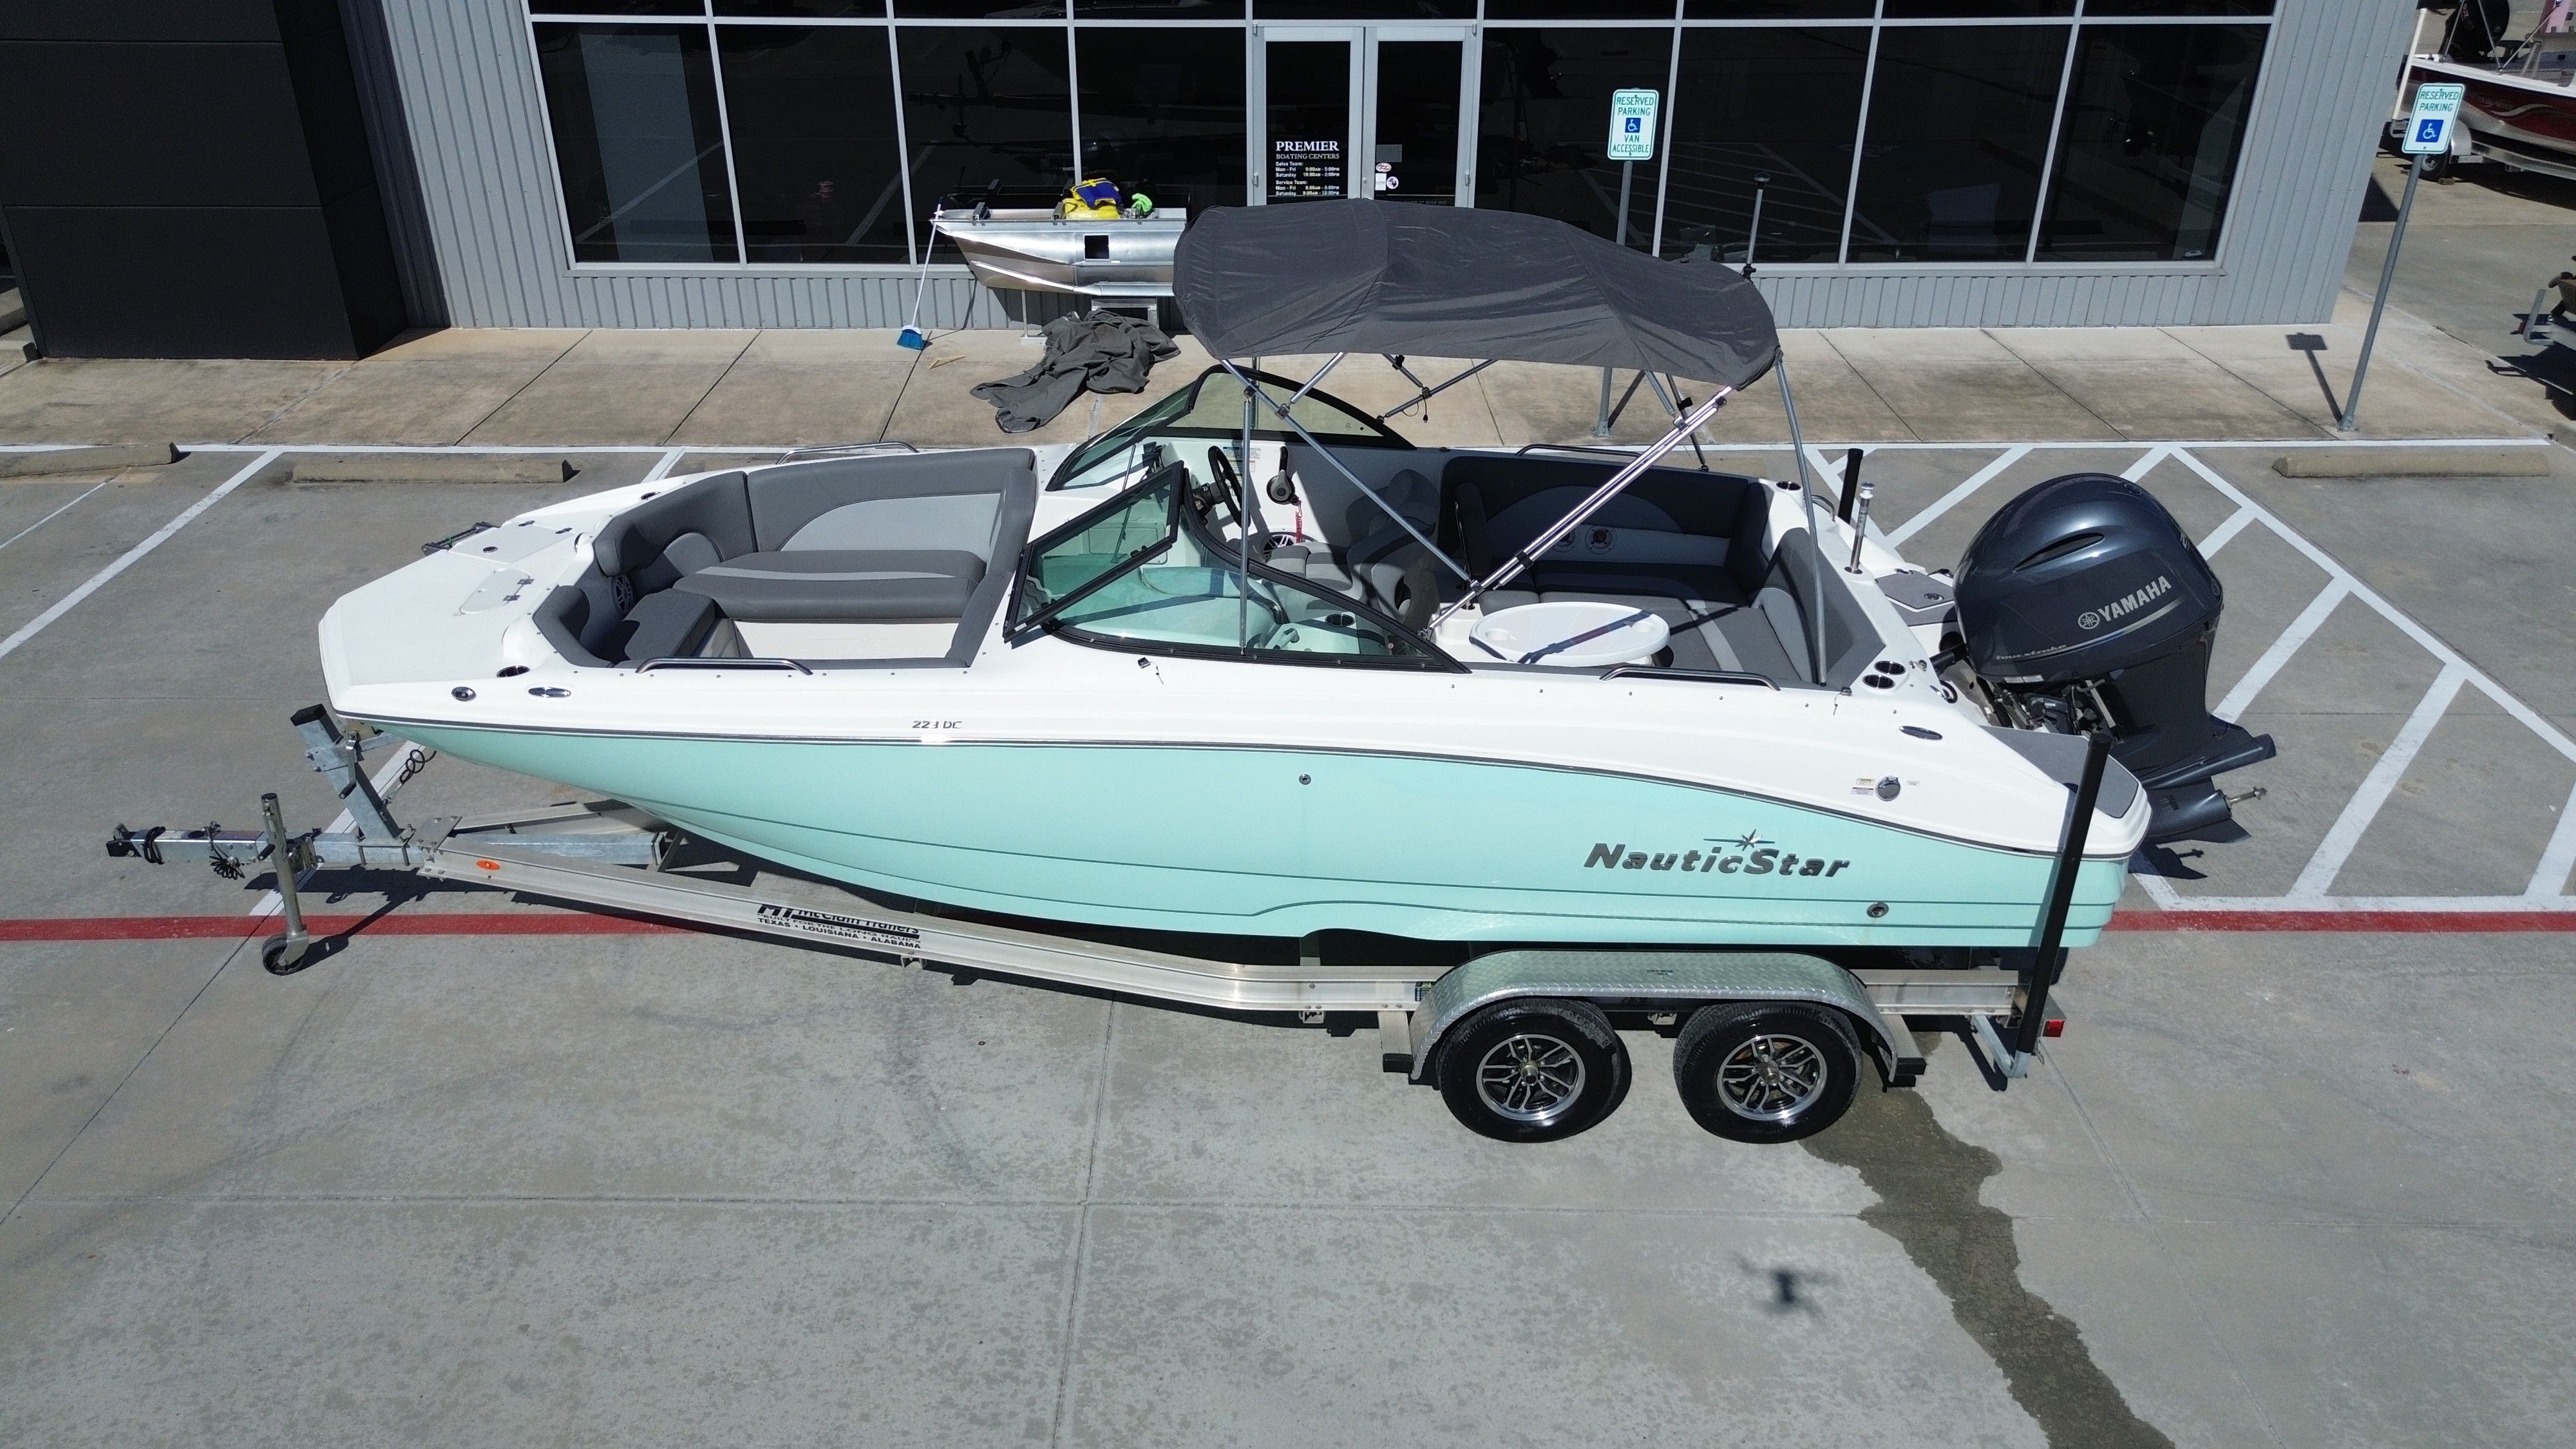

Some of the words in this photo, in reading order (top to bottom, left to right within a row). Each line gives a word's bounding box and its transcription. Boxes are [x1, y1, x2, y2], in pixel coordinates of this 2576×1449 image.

[2420, 91, 2459, 100] RESERVED
[1616, 97, 1654, 106] RESERVED
[1618, 107, 1651, 116] PARKING
[2419, 103, 2454, 112] PARKING
[1624, 135, 1640, 143] VAN
[1276, 141, 1340, 151] PREMIER
[1612, 144, 1649, 153] ACCESSIBLE
[2097, 575, 2172, 622] YAMAHA
[943, 721, 962, 729] DC
[1583, 842, 1850, 878] NauticStar
[757, 917, 791, 927] TEXAS
[802, 924, 859, 939] LOUISIANA
[871, 936, 921, 949] ALABAMA
[839, 927, 877, 936] LONG
